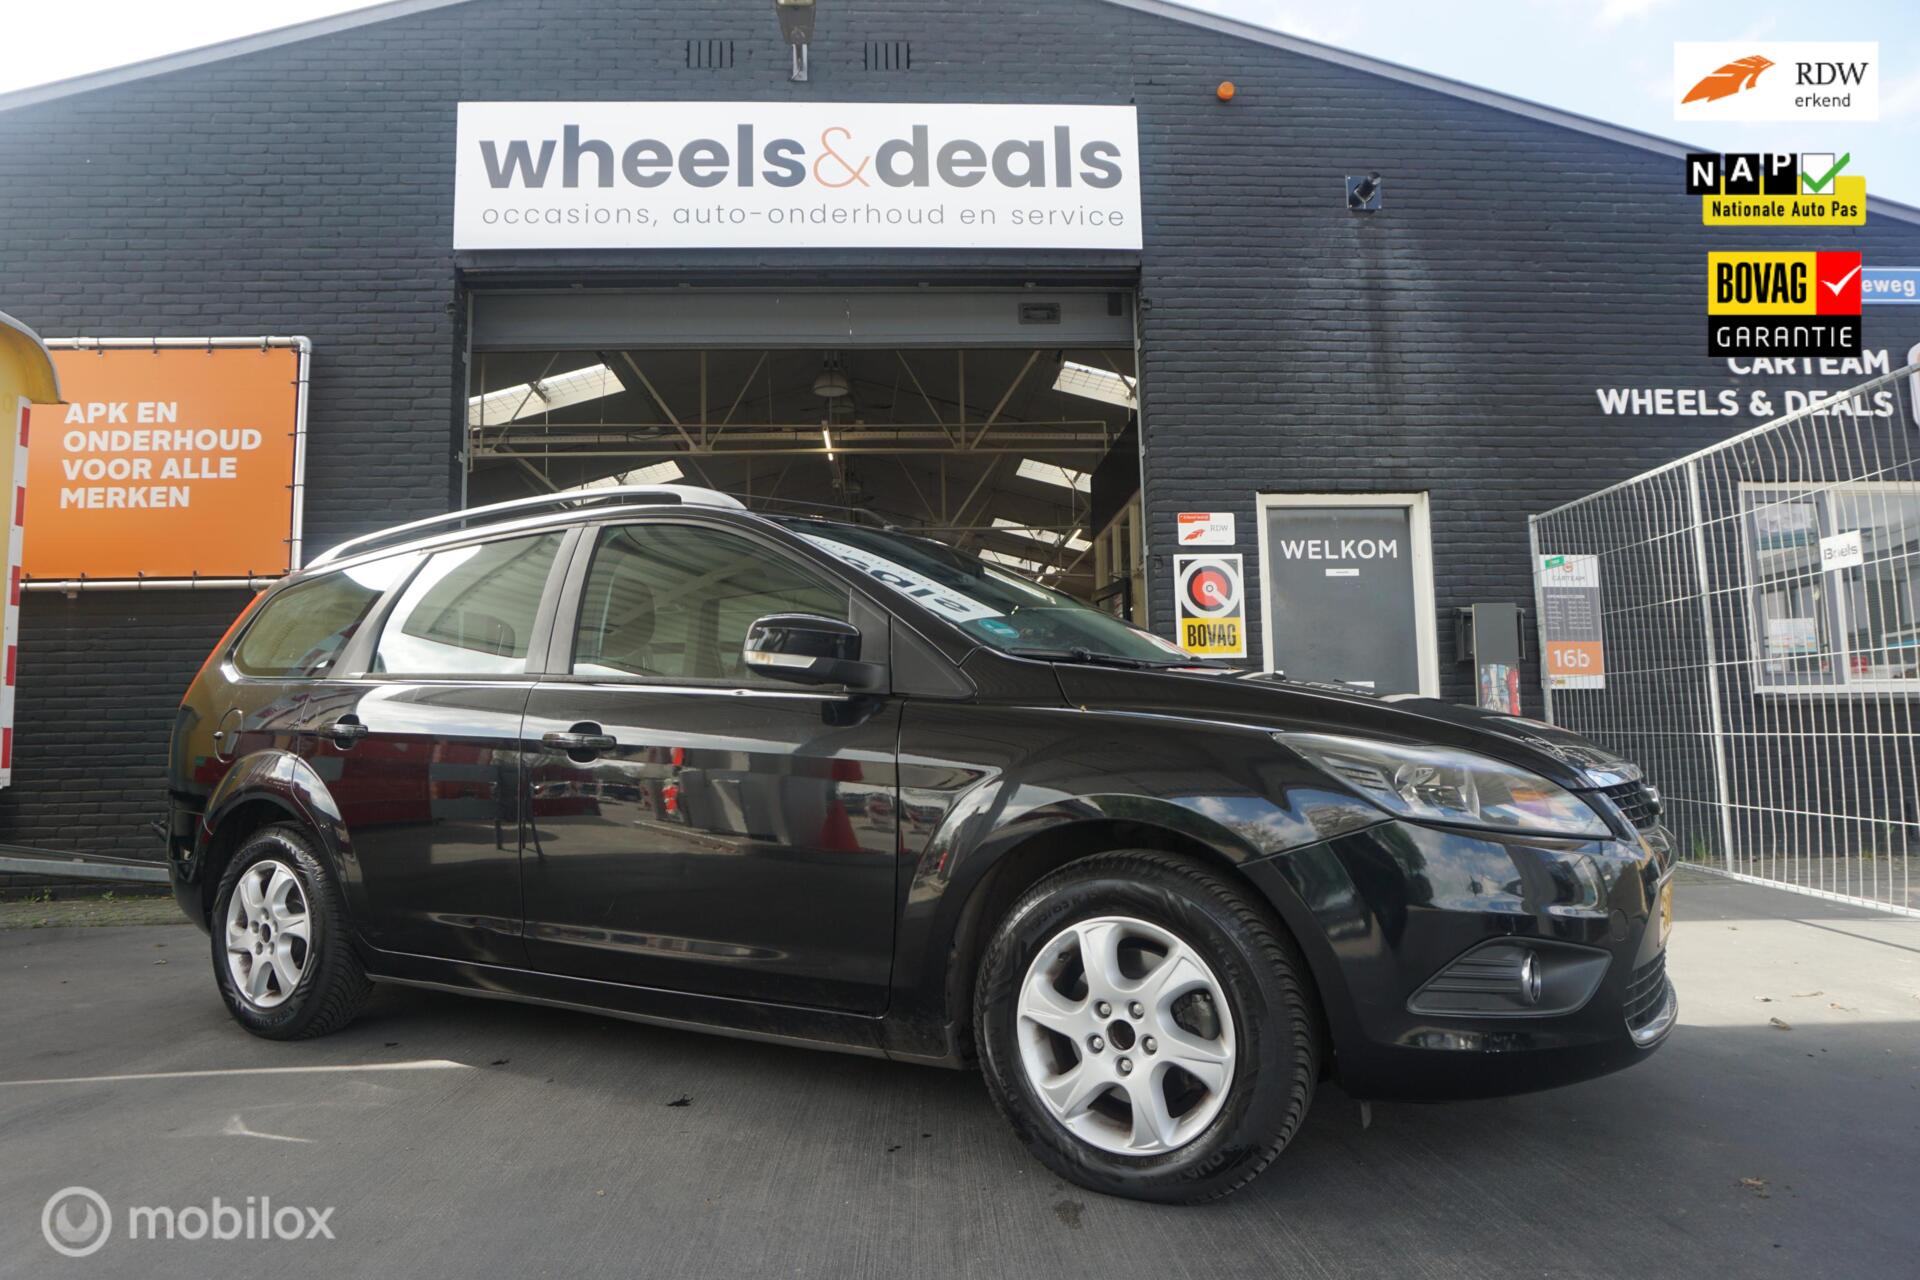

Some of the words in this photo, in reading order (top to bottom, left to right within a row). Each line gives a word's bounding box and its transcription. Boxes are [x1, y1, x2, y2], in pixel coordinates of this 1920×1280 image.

[478, 123, 1123, 190] wheels&deals
[482, 202, 660, 228] occasions,
[672, 203, 946, 226] auto-onderhoud
[959, 210, 997, 226] en
[1010, 204, 1125, 227] service
[1726, 349, 1889, 375] CARTEAM
[64, 402, 128, 424] APK
[137, 401, 177, 423] EN
[1597, 387, 1740, 417] WHEELS
[1749, 389, 1775, 417] &
[1784, 390, 1894, 417] DEALS
[63, 429, 262, 452] ONDERHOUD
[62, 458, 152, 481] VOOR
[160, 457, 237, 479] ALLE
[60, 486, 190, 509] MERKEN
[1280, 539, 1398, 560] WELKOM
[1187, 623, 1237, 647] BOVAG
[1553, 648, 1591, 668] 16b
